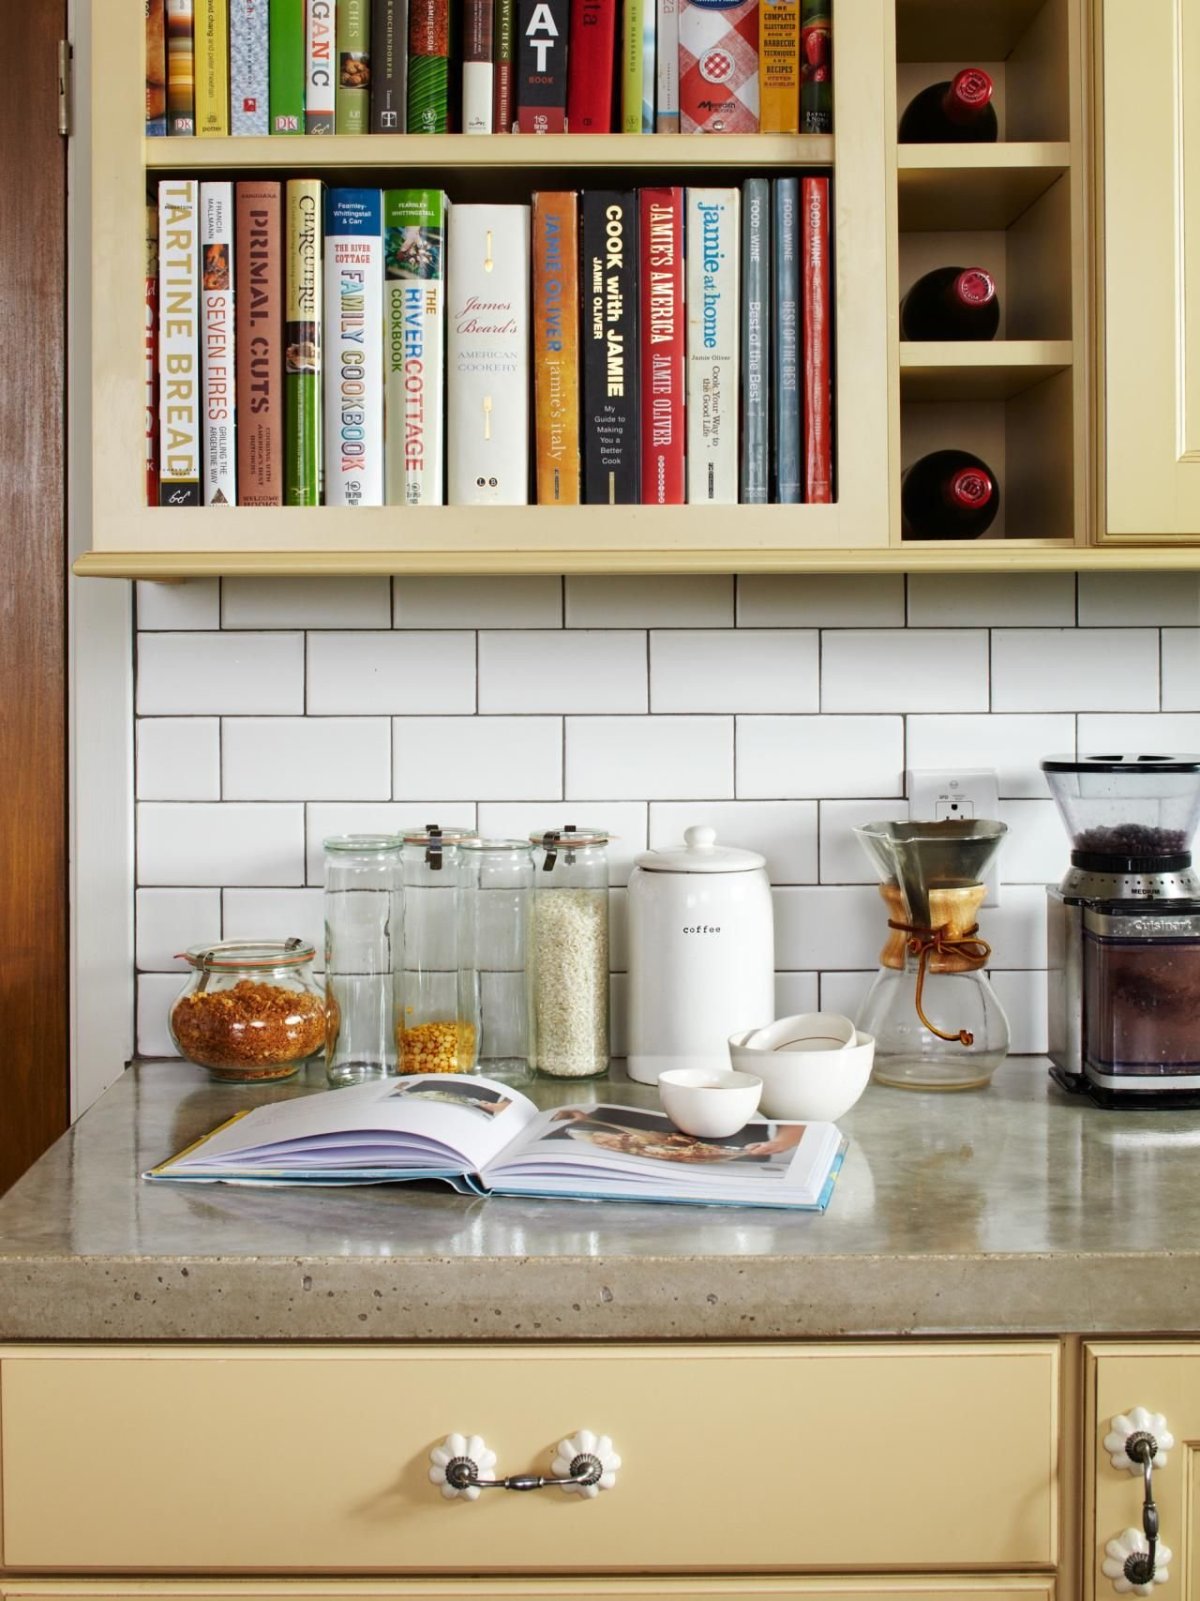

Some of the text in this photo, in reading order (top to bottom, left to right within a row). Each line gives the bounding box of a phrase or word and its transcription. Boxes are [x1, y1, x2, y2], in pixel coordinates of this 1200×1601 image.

[207, 15, 215, 37] chang
[583, 0, 601, 26] ta
[764, 13, 796, 21] COMPLETE
[311, 0, 330, 86] GANIC
[764, 39, 796, 47] BARBECUE
[528, 76, 554, 84] BOOK
[766, 65, 793, 73] RECIPES
[175, 118, 192, 130] DK
[275, 116, 298, 132] DK
[165, 182, 192, 338] TARTINE
[250, 210, 268, 327] PRIMAL
[299, 196, 315, 313] CHARCUTERIE
[335, 244, 370, 252] THE RIVER
[335, 255, 370, 263] COTTAGE
[544, 214, 562, 351] JAMIE OLIVER
[593, 257, 602, 339] JAMIE OLIVER
[650, 204, 673, 345] JAMIE'S AMERICA
[698, 202, 724, 348] jamie at home
[426, 289, 436, 315] THE
[455, 295, 511, 319] James
[456, 318, 517, 334] Beard's
[606, 205, 624, 397] COOK with JAMIE
[392, 289, 402, 372] COOKBOOK
[458, 351, 518, 359] AMERICAN
[749, 301, 761, 402] Best of the Best
[783, 301, 795, 391] BEST OF THE BEST
[207, 297, 226, 419] SEVEN FIRES
[251, 338, 269, 413] CUTS
[341, 270, 365, 472] FAMILY COOKBOOK
[458, 363, 518, 372] COOKERY
[167, 354, 193, 471] BREAD
[545, 360, 566, 461] jamie's italy
[604, 405, 615, 413] My
[652, 354, 672, 447] JAMIE OLIVER
[703, 378, 711, 437] the Good Life
[709, 366, 720, 446] Cook Your Way to
[209, 426, 217, 467] ARGENTINE
[219, 426, 227, 459] GRILLING
[682, 925, 721, 934] coffee
[1134, 920, 1192, 931] Cuisinart
